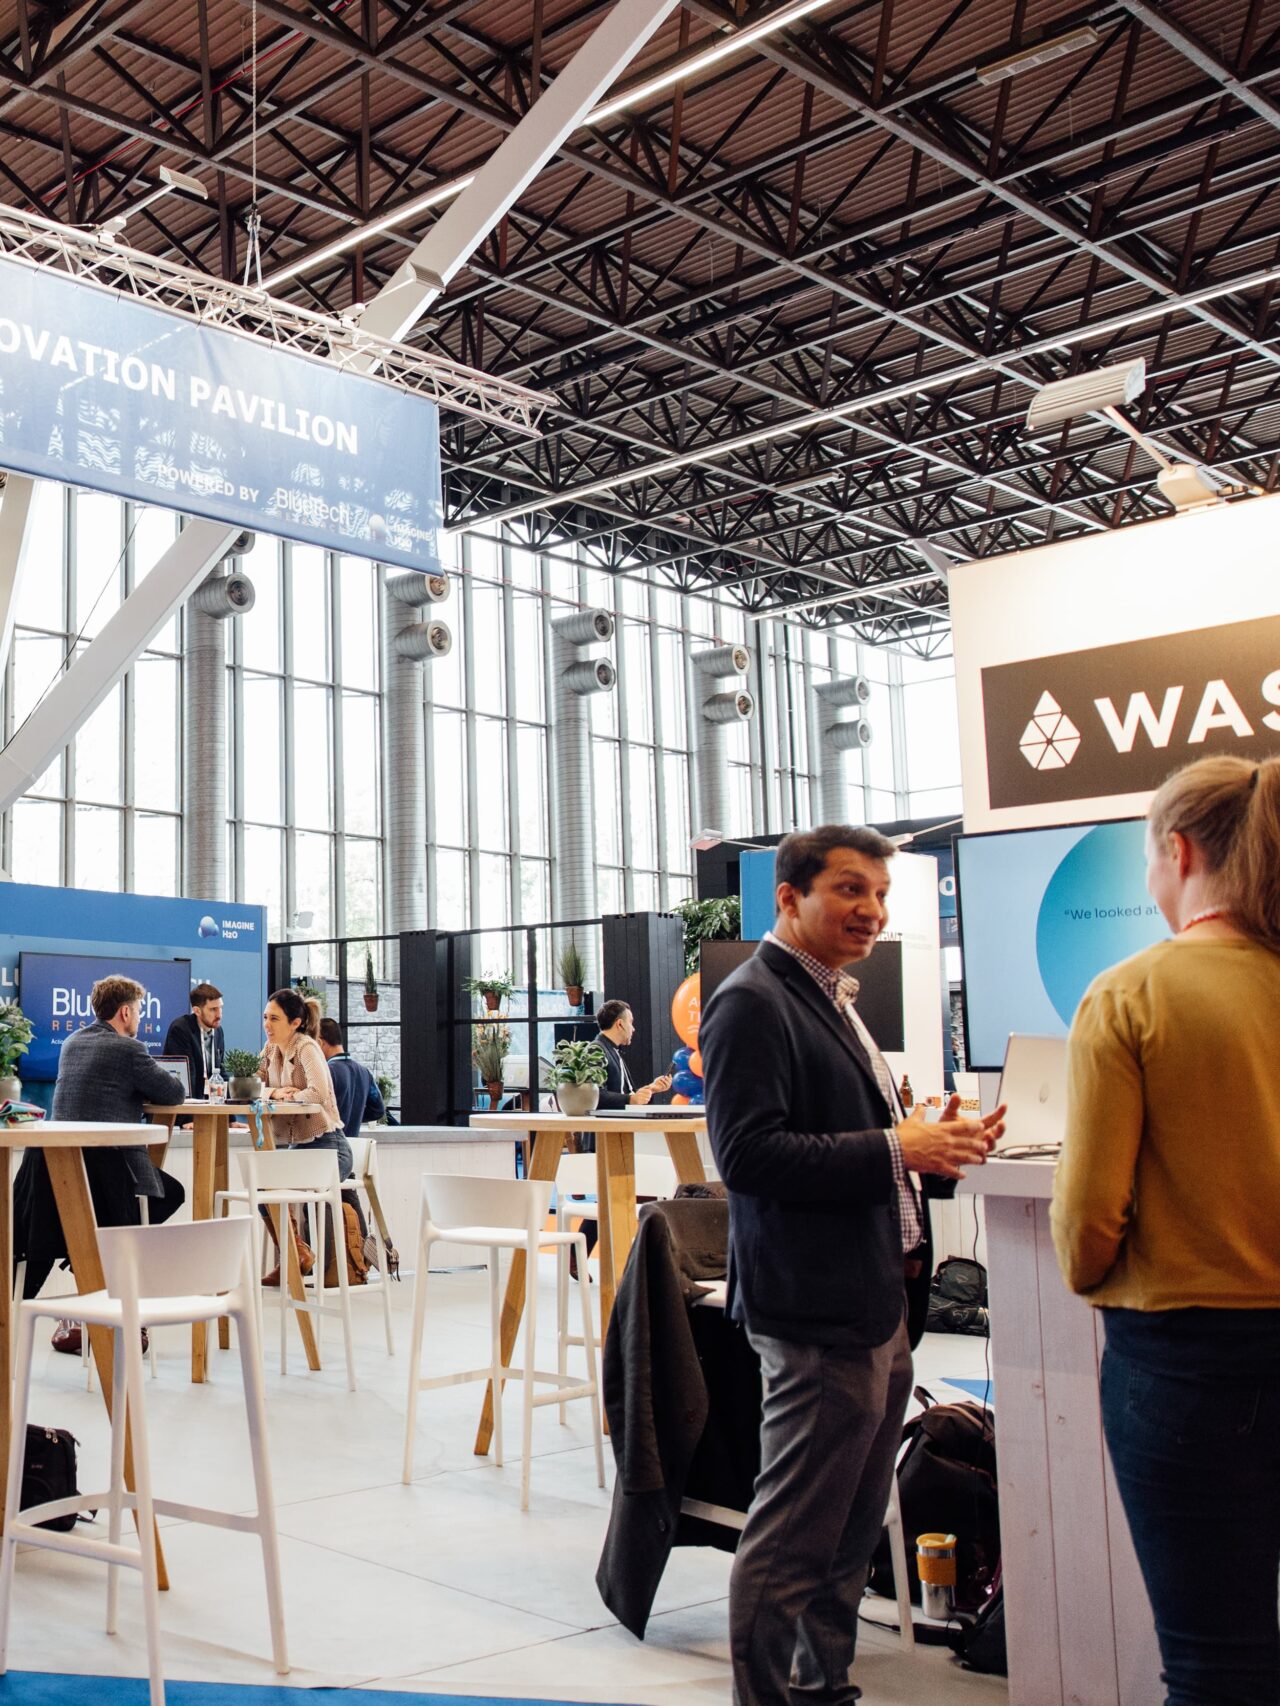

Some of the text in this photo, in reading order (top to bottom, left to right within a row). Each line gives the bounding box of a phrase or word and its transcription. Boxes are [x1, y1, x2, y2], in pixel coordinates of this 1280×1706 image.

[190, 376, 358, 455] PAVILION
[158, 464, 260, 503] POWERED BY
[1095, 905, 1142, 919] looked
[222, 920, 255, 931] IMAGINE
